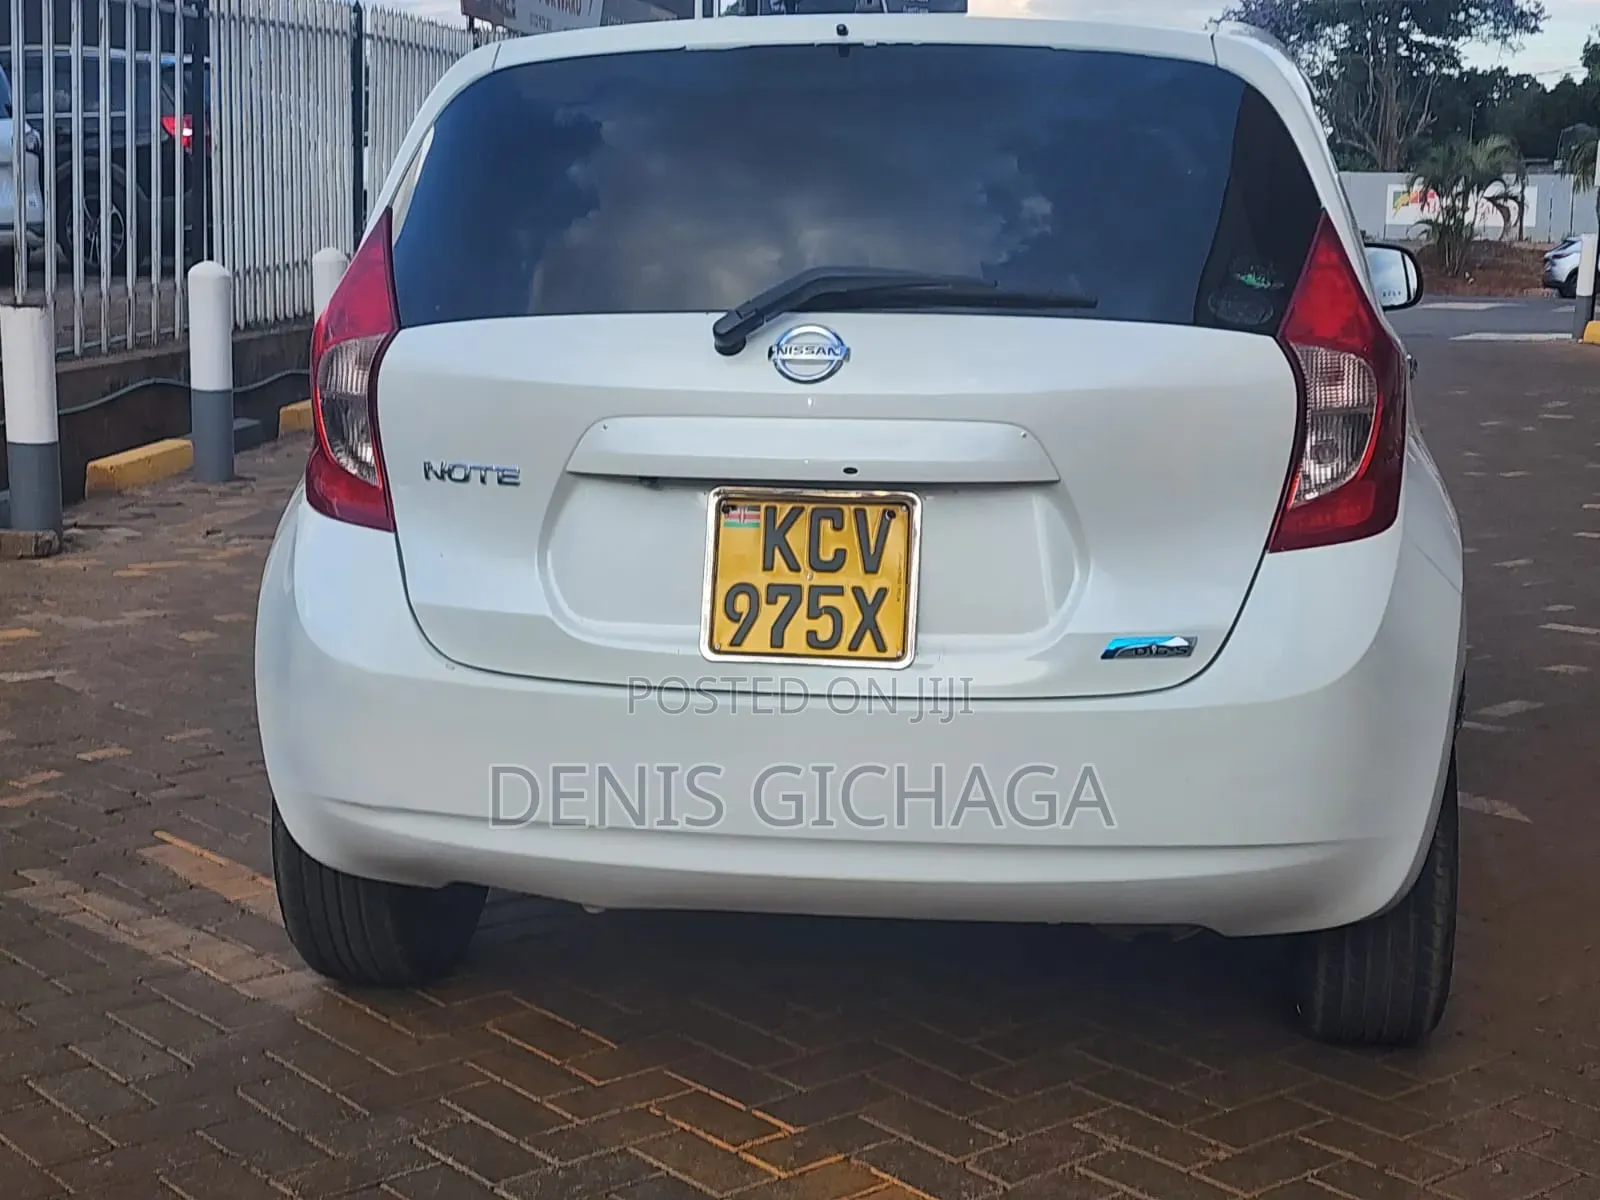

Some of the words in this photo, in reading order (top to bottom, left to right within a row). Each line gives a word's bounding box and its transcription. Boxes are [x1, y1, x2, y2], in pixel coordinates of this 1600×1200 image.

[776, 344, 842, 356] NISSAN
[423, 460, 521, 486] NOTE
[762, 505, 894, 574] KCV
[723, 582, 889, 653] 975X
